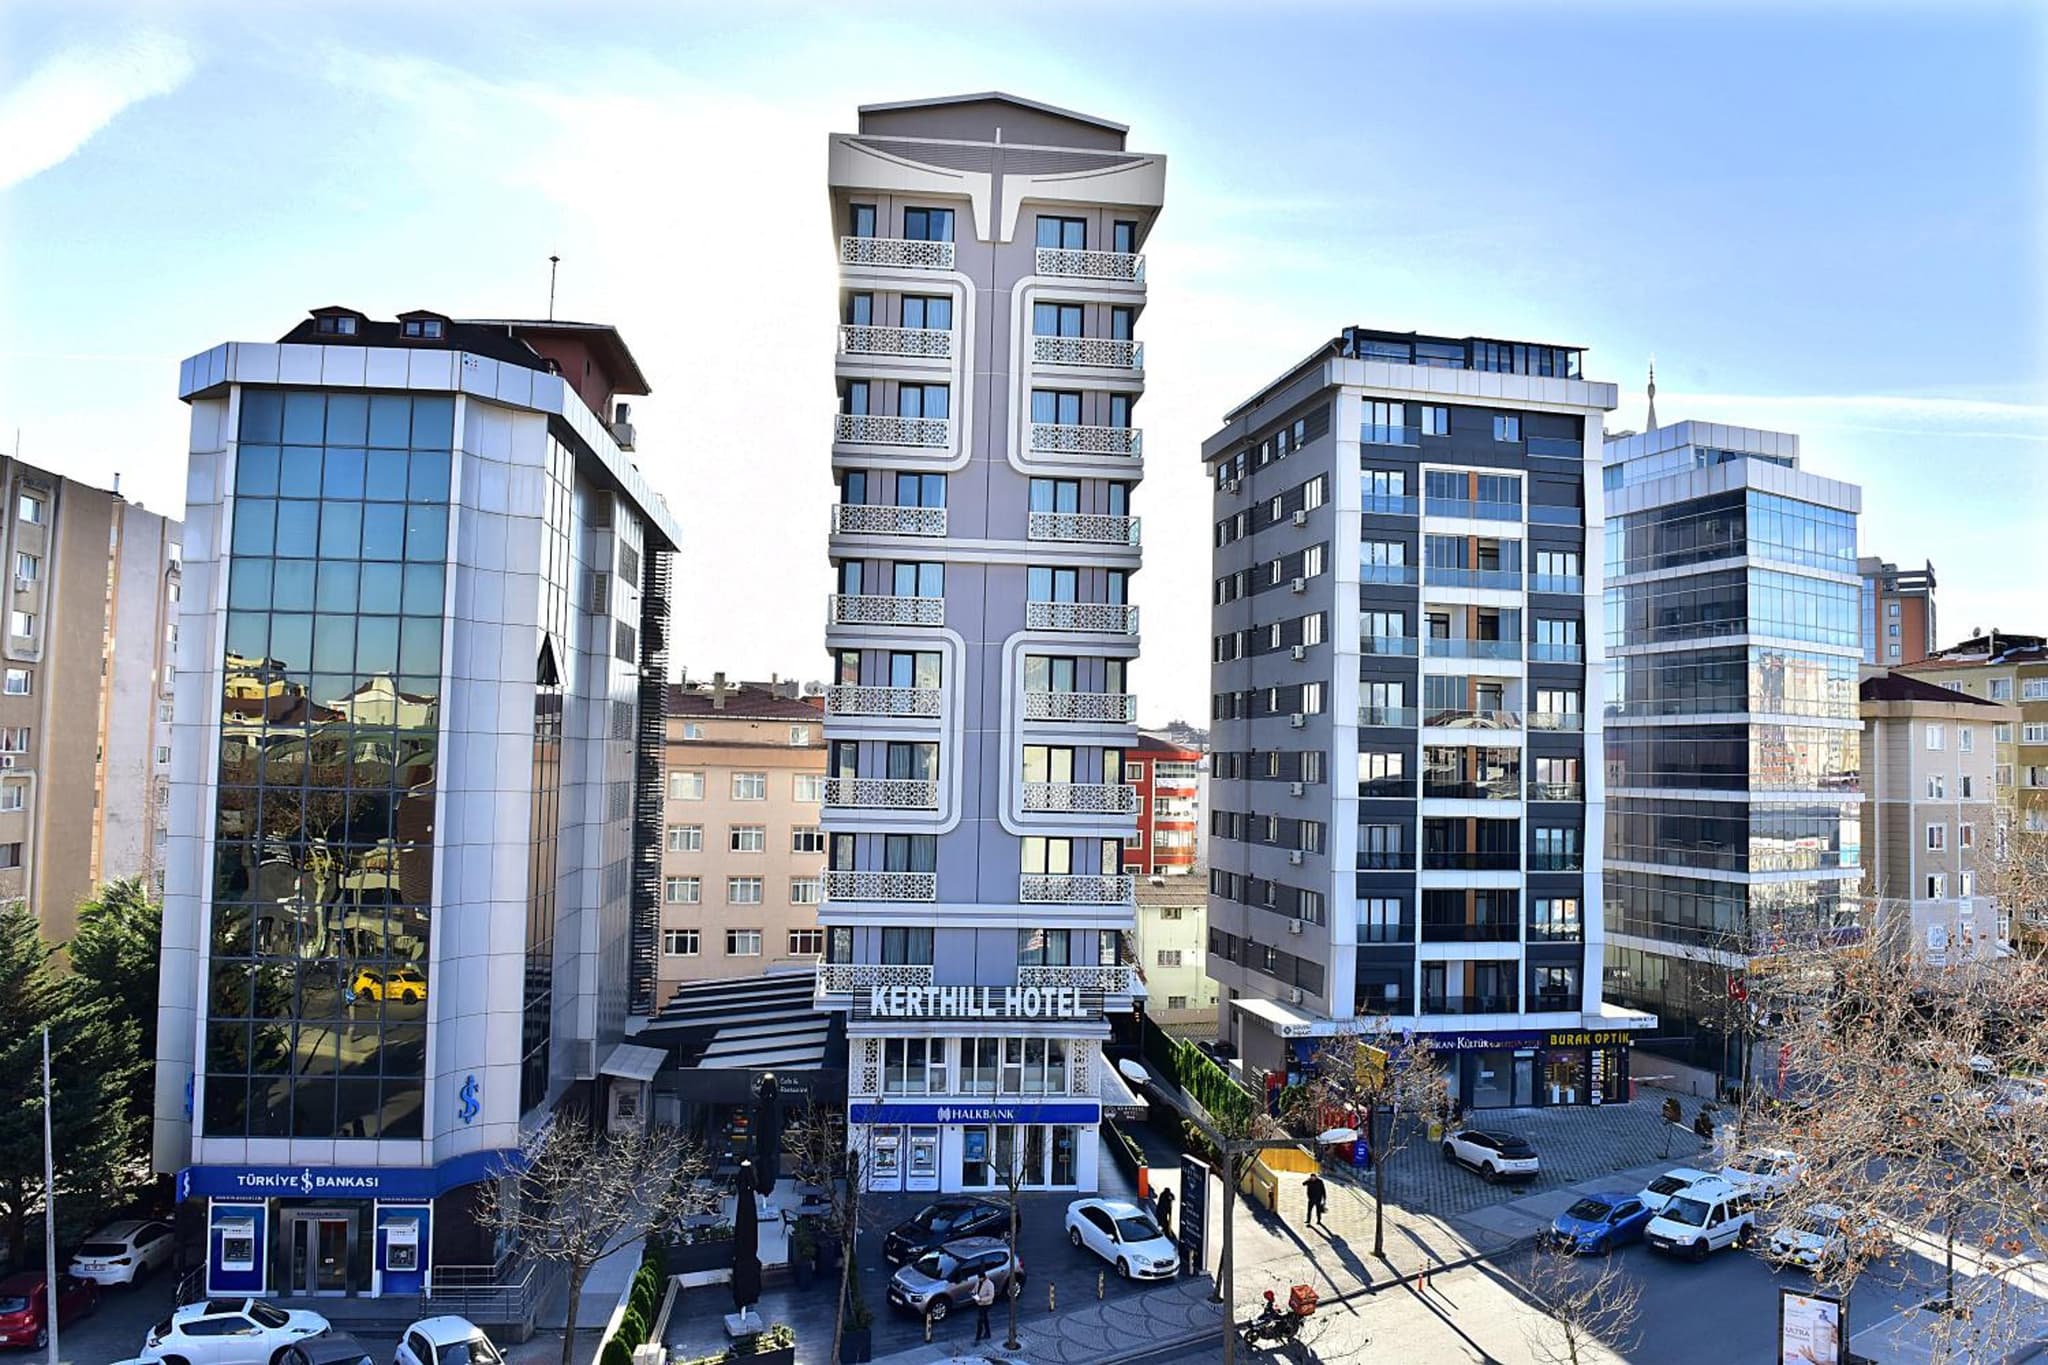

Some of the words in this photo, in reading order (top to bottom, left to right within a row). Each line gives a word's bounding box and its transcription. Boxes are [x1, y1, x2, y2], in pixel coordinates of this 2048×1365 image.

[870, 986, 997, 1017] KERTHILL
[1004, 986, 1088, 1018] HOTEL
[1550, 1033, 1591, 1046] BURAK
[952, 1108, 1014, 1120] HALKBANK
[237, 1173, 299, 1187] TÜRKİYE
[316, 1176, 379, 1188] BANKASI
